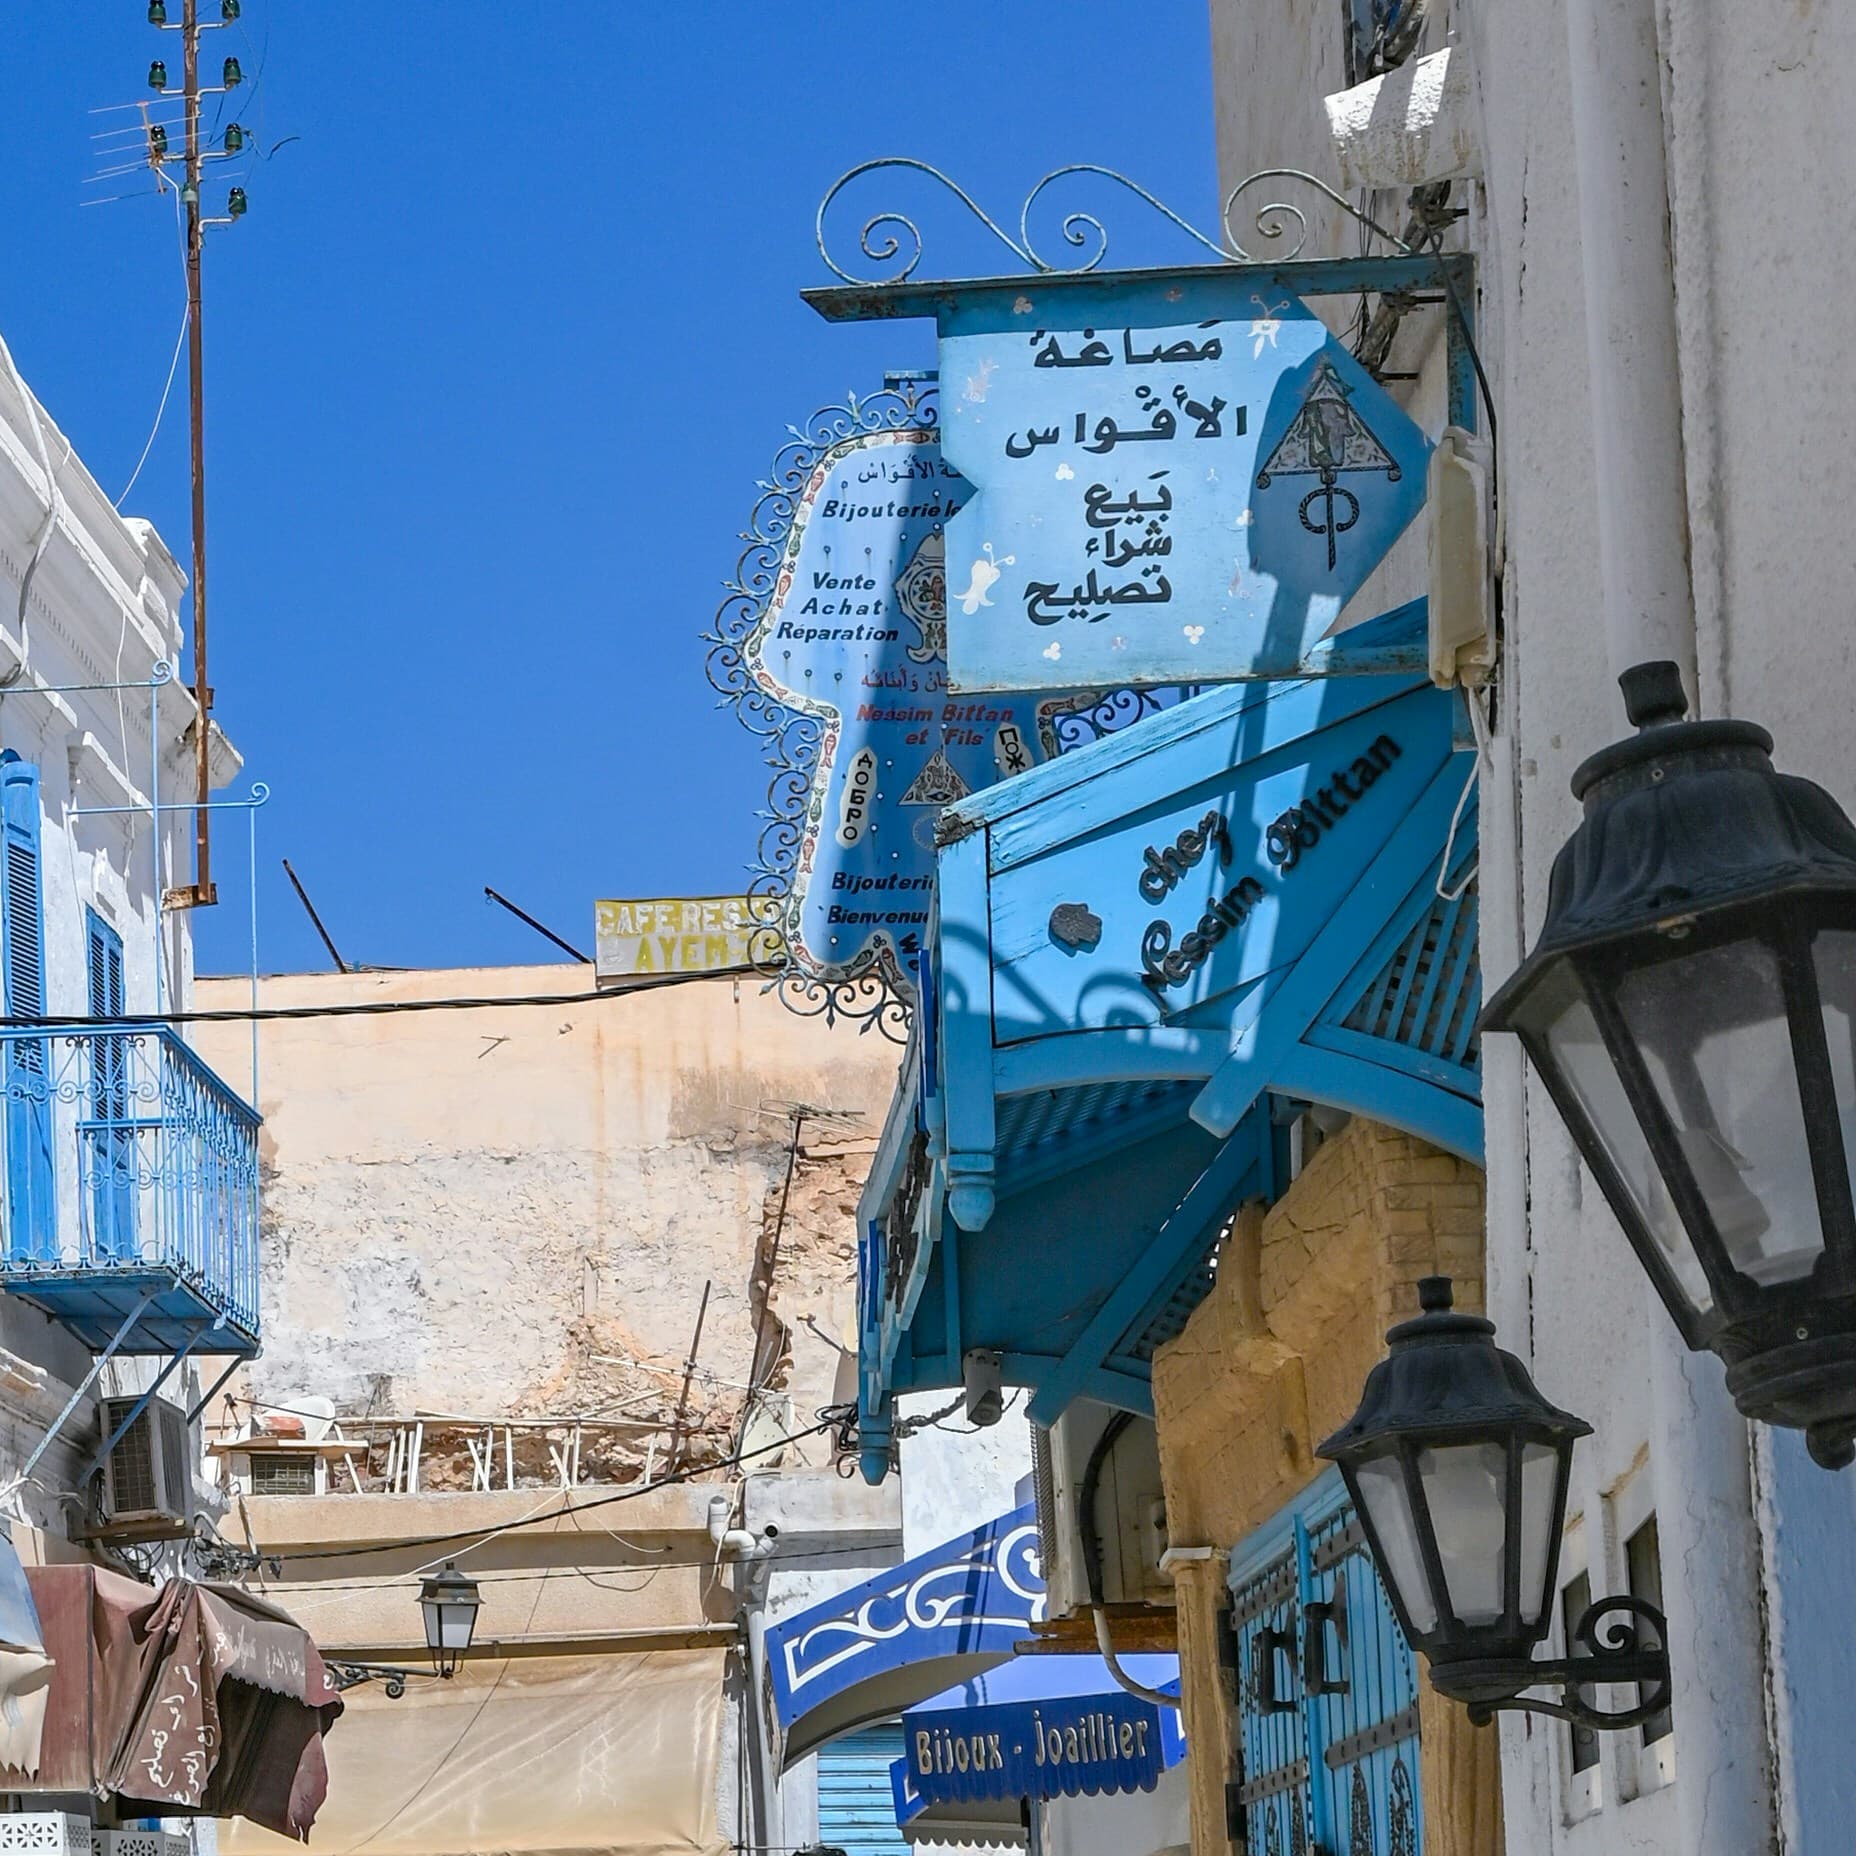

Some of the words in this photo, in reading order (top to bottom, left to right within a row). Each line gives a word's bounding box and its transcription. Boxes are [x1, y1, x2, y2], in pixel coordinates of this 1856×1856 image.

[822, 500, 941, 522] Bijouterie
[1085, 520, 1173, 568] شراء
[812, 572, 876, 591] Vente
[800, 597, 883, 616] Achat
[776, 621, 899, 644] Réparation
[856, 702, 933, 722] Nessim
[941, 702, 1014, 722] Bittan
[905, 728, 929, 745] et
[944, 727, 984, 746] Fils
[915, 1728, 1003, 1776] Bijoux
